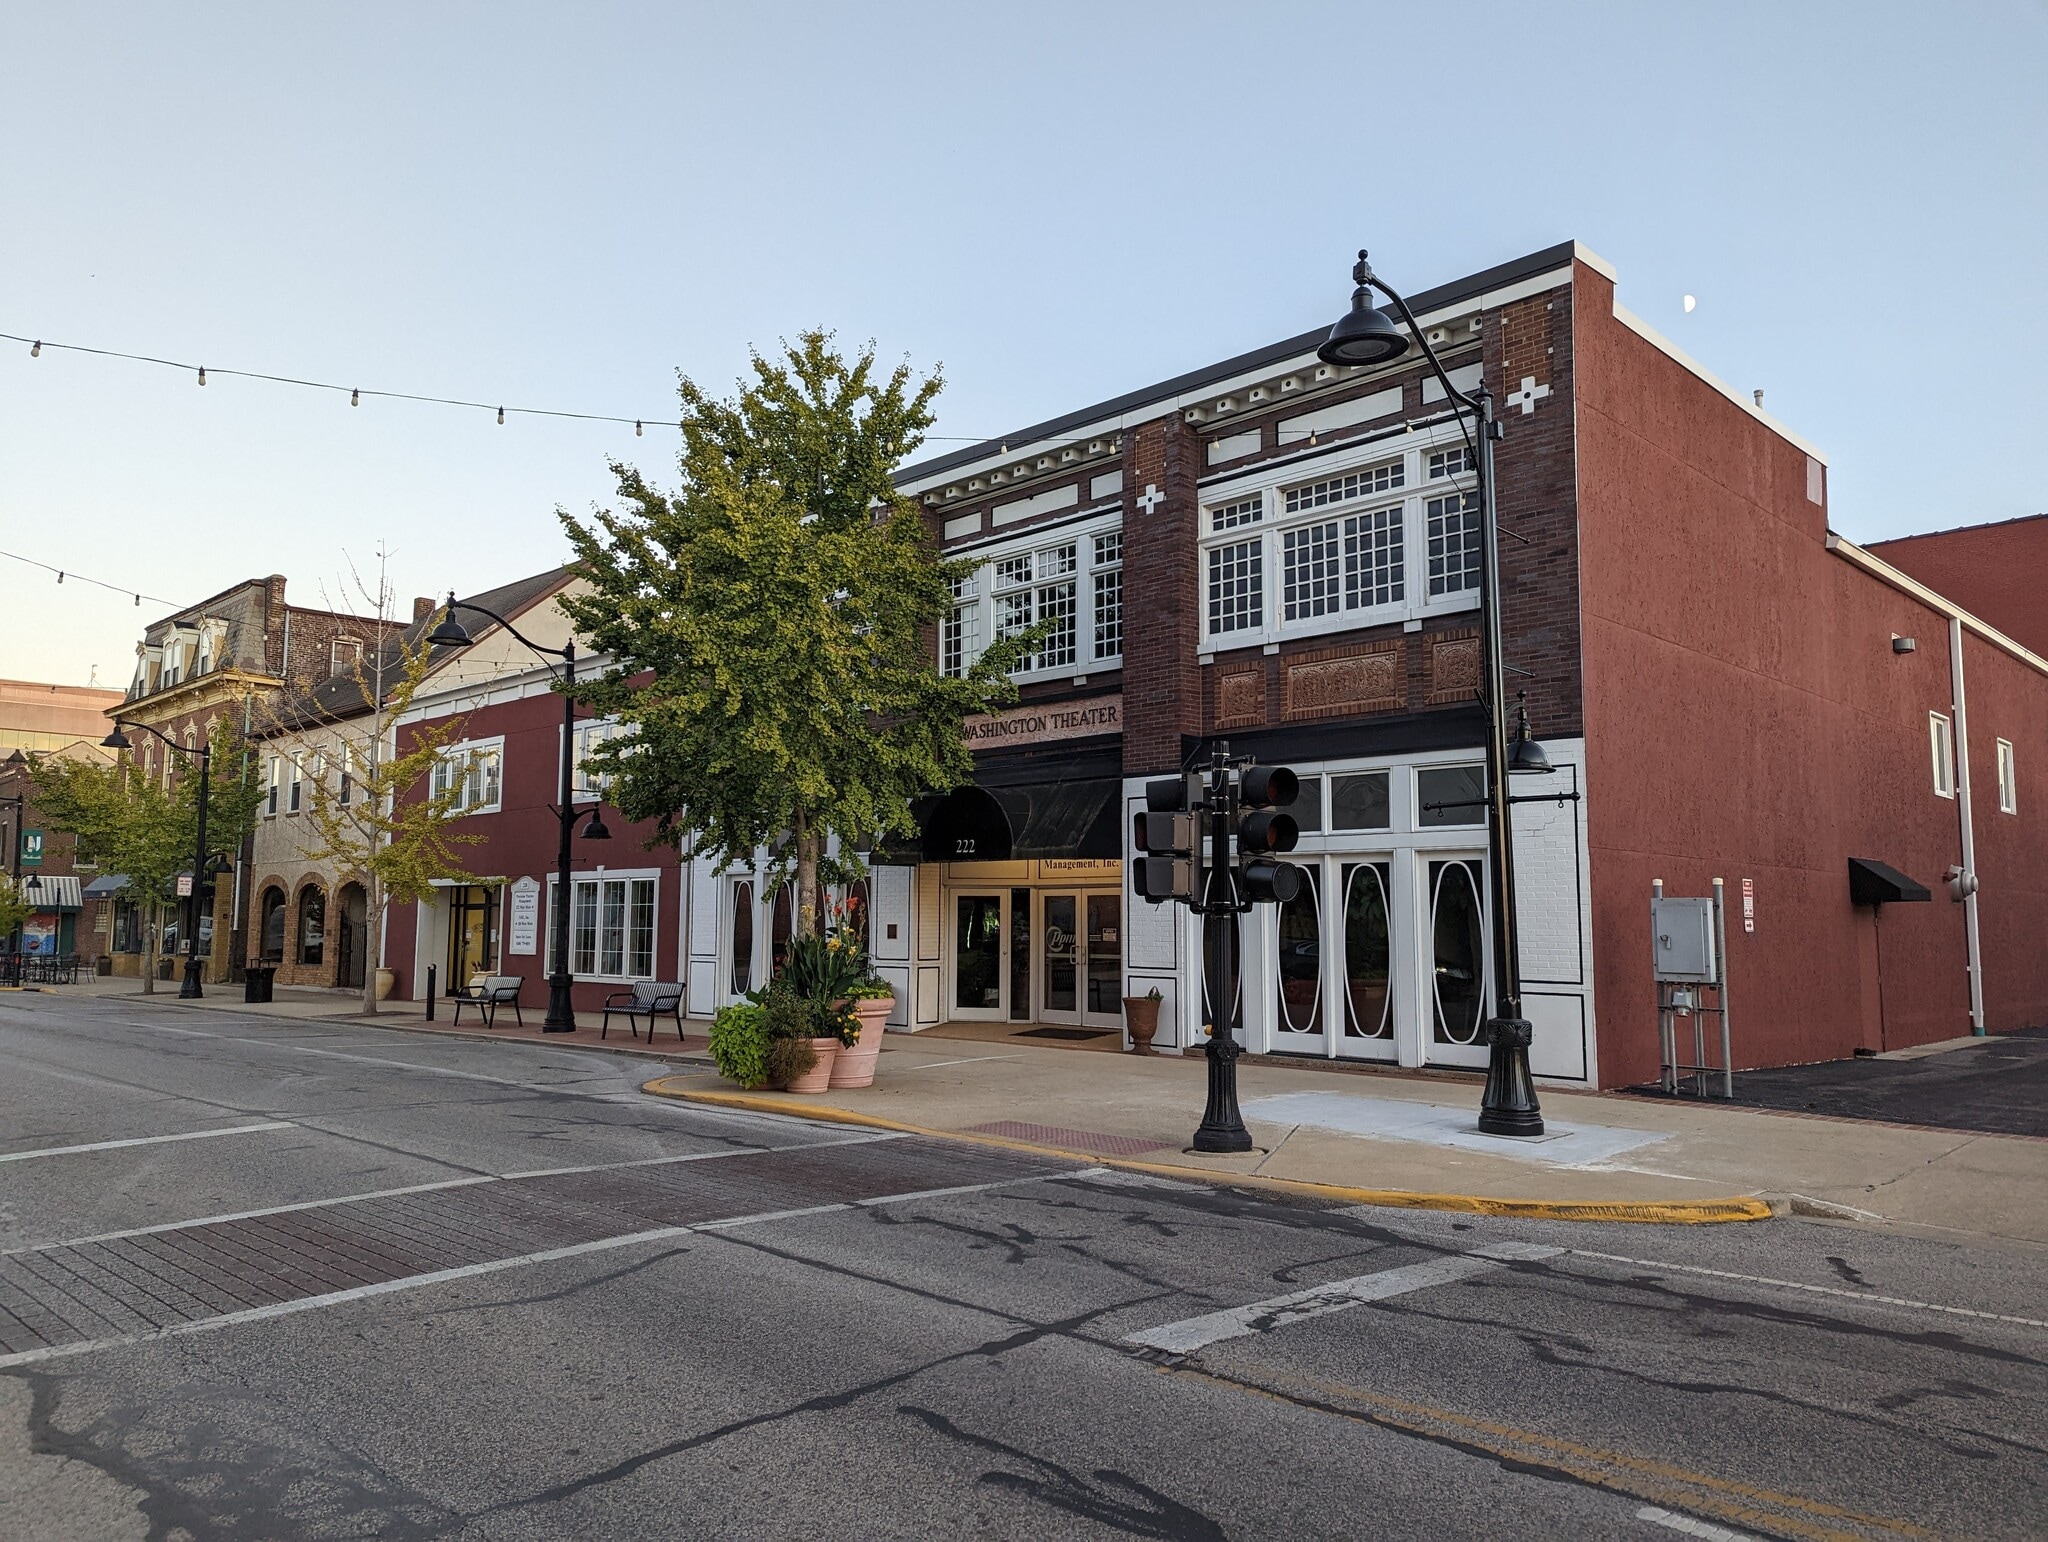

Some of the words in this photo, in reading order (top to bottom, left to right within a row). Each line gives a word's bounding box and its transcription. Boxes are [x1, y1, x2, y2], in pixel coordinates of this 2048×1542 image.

[963, 715, 1047, 741] WASHINGTON
[1050, 706, 1119, 729] THEATER
[956, 839, 976, 853] 222
[1045, 859, 1099, 870] Management,
[1102, 859, 1119, 868] Inc.
